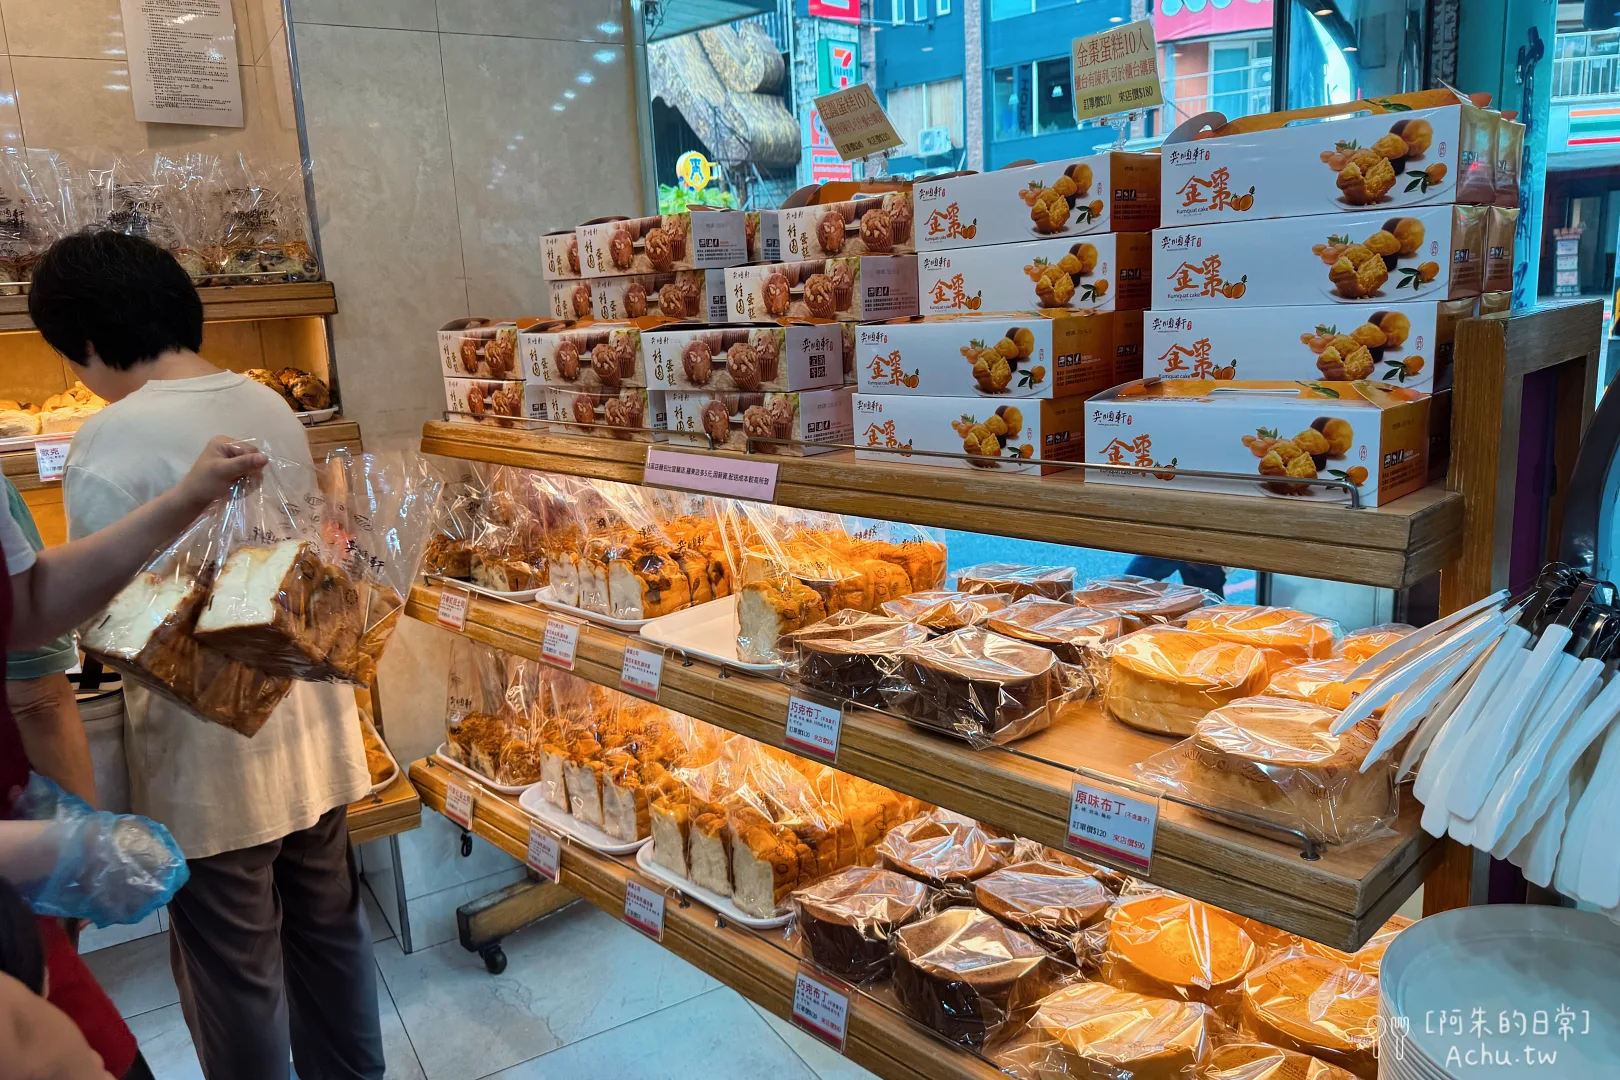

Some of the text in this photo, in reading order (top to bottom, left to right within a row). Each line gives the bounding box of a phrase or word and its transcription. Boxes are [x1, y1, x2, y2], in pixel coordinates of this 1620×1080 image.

[1118, 86, 1154, 103] 來店價$180
[1176, 167, 1231, 211] 金棗
[1176, 207, 1197, 215] Kumquat
[1167, 254, 1223, 298] 金棗
[1167, 292, 1189, 300] Kumquat
[1158, 337, 1213, 380] 金棗
[790, 701, 822, 720] 巧克布丁
[1075, 790, 1150, 824] 原味布丁 (不含盒子)
[1072, 821, 1146, 850] 訂單價$120 來店價$90
[797, 978, 829, 1002] 巧克布丁
